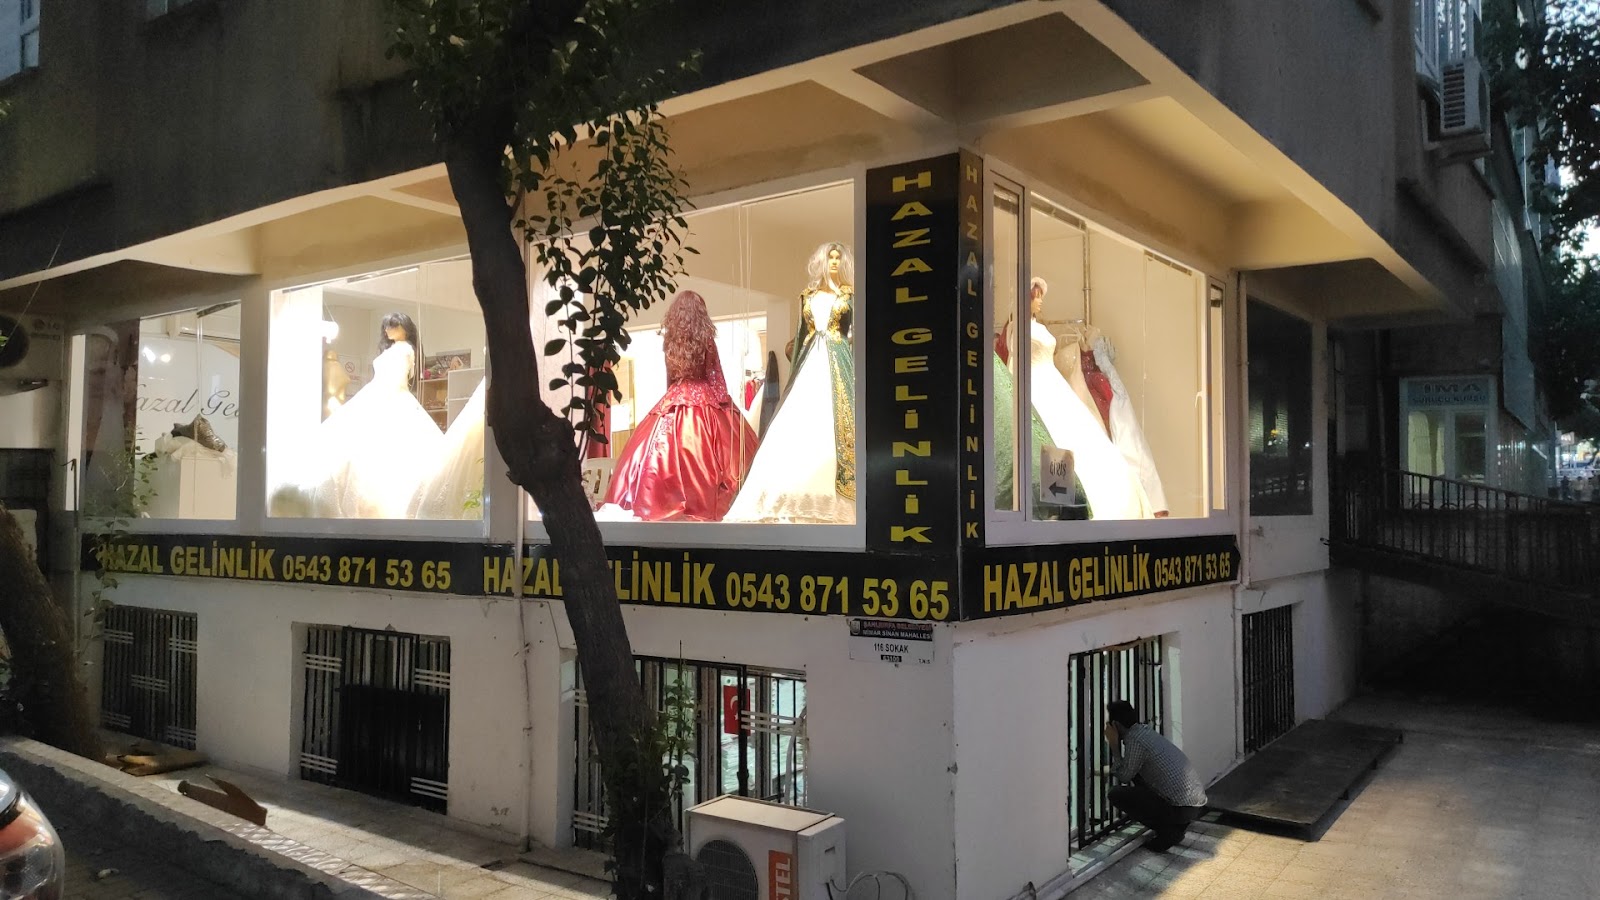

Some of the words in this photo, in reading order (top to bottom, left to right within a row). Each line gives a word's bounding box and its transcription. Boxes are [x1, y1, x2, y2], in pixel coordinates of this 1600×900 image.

[888, 171, 933, 304] HAZAL
[965, 164, 979, 297] HAZAL
[136, 383, 199, 414] azal
[965, 322, 979, 539] GELİNLİK
[890, 327, 933, 543] GELİNLİK
[170, 541, 276, 579] GELİNLİK
[282, 555, 331, 582] 0543
[338, 557, 376, 584] 871
[385, 559, 414, 587] 53
[421, 561, 452, 590] 65
[608, 551, 716, 605] LİNLİK
[725, 572, 791, 609] 0543
[799, 575, 849, 614] 871
[862, 577, 899, 617] 53
[909, 579, 950, 620] 65
[984, 560, 1064, 612] HAZAL
[1069, 545, 1151, 600] GELİNLİK
[1154, 557, 1182, 588] 0543
[1184, 554, 1202, 586] 871
[1205, 553, 1218, 580] 53
[1219, 551, 1231, 578] 65
[885, 644, 909, 653] SOKAK
[775, 858, 791, 900] TEL
